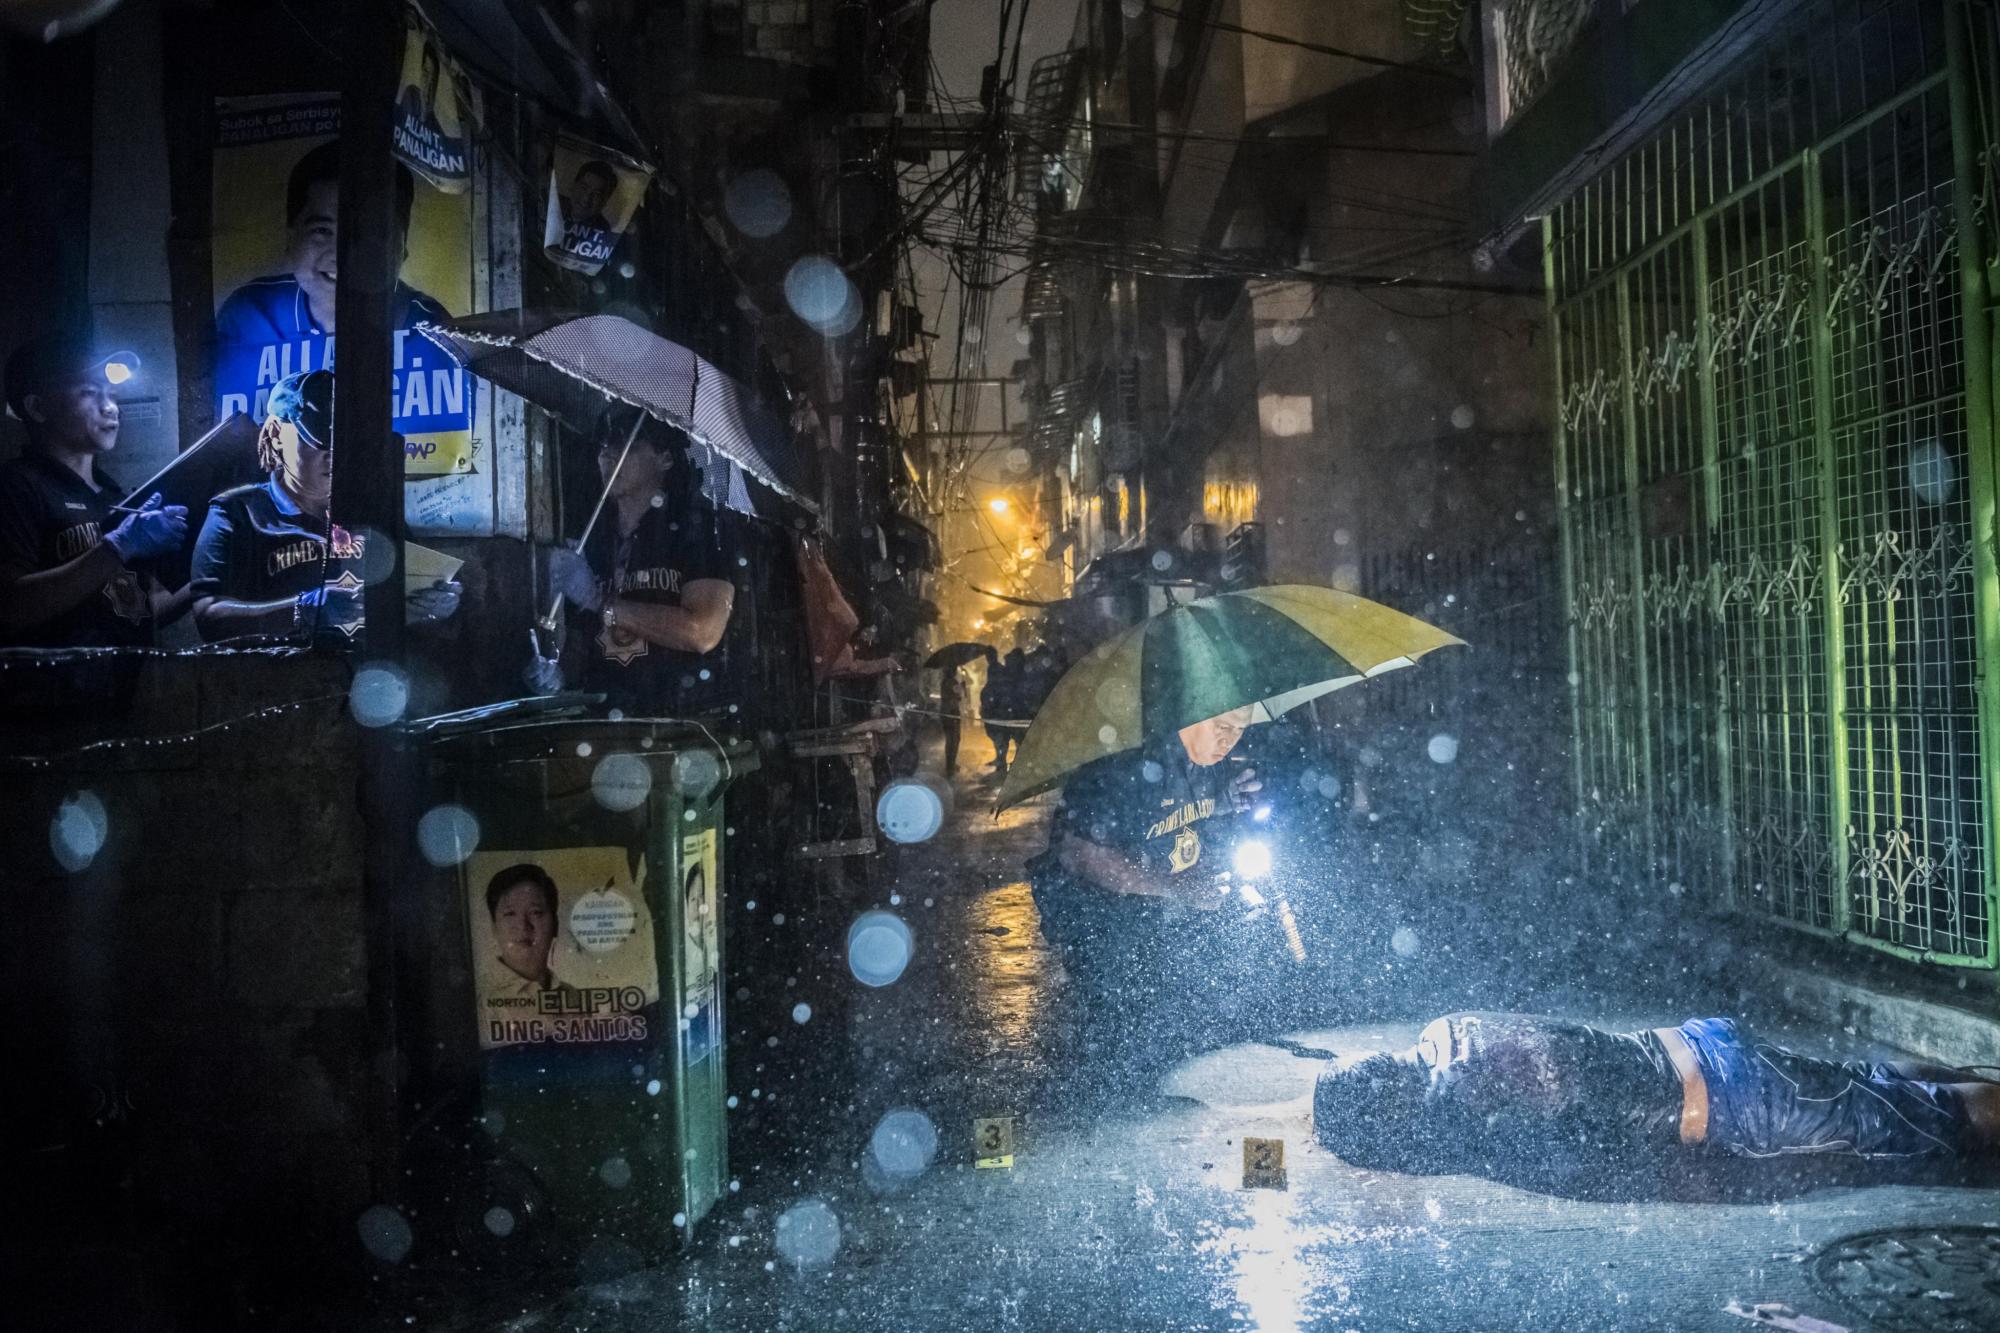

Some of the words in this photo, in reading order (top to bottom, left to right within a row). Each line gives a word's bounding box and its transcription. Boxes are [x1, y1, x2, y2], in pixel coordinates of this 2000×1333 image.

[393, 125, 465, 172] PANALIGAN
[487, 998, 536, 1008] NORTON
[538, 986, 645, 1014] ELIPIO
[490, 1019, 546, 1043] DING
[553, 1015, 648, 1043] SANTOS
[985, 1124, 1001, 1150] 3
[1253, 1143, 1272, 1170] 2
